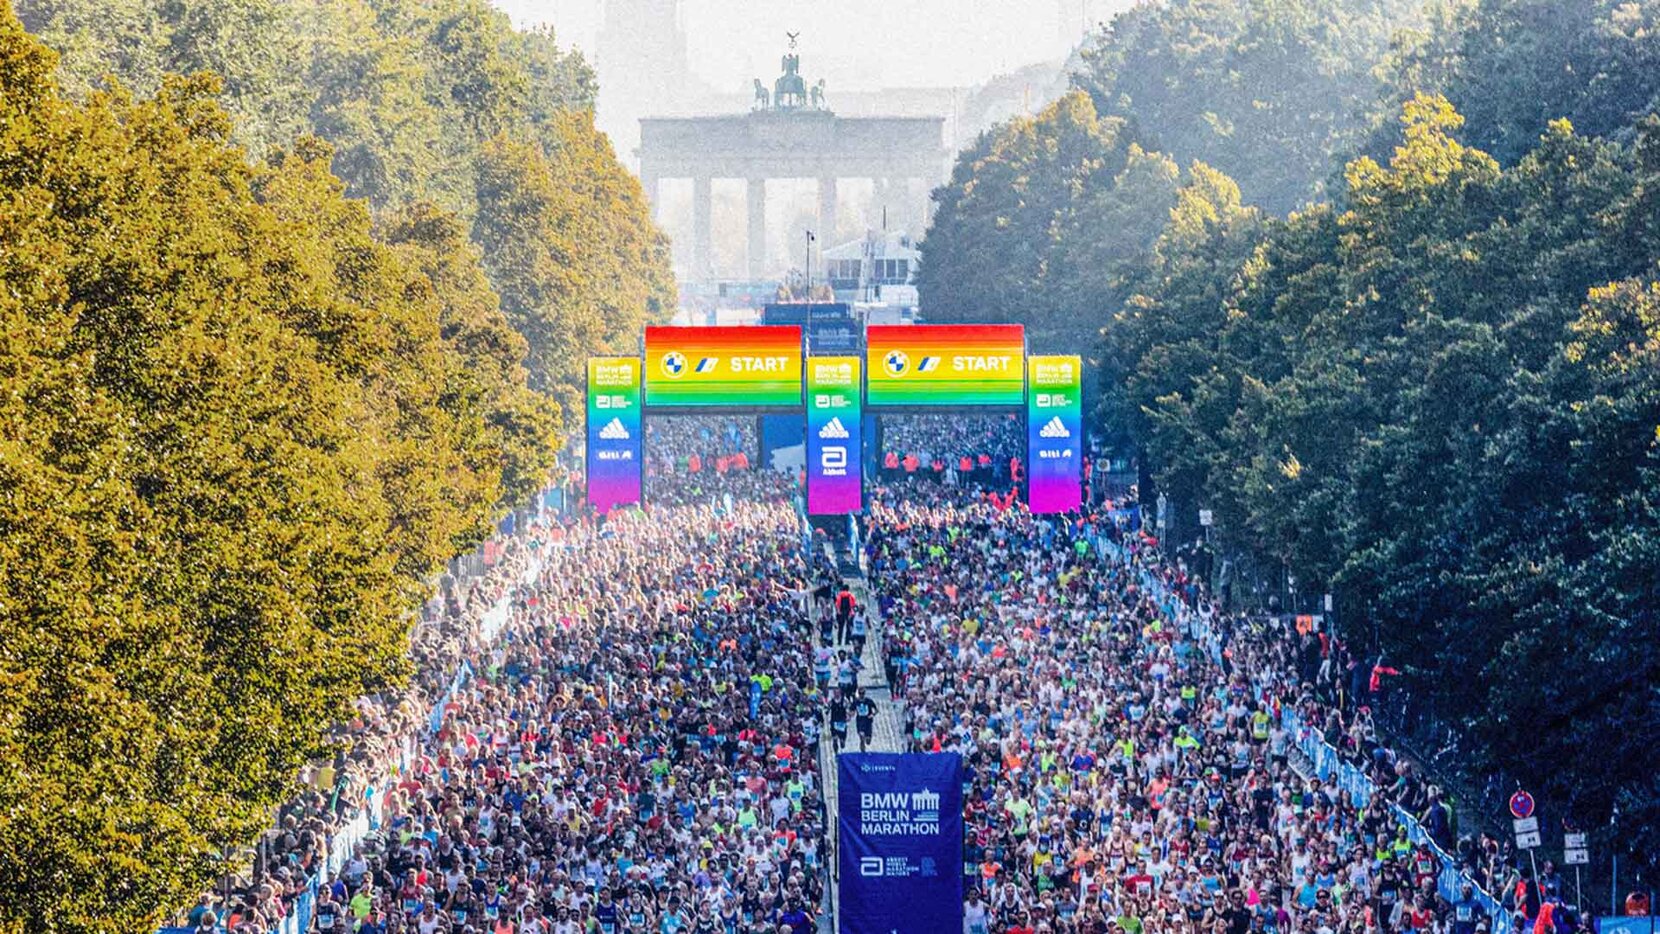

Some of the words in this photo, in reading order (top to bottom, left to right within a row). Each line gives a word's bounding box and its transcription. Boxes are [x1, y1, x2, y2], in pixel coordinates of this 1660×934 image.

[730, 356, 789, 372] START
[952, 355, 1012, 371] START
[861, 792, 909, 809] BMW
[861, 810, 910, 822] BERLIN
[861, 822, 940, 835] MARATHON
